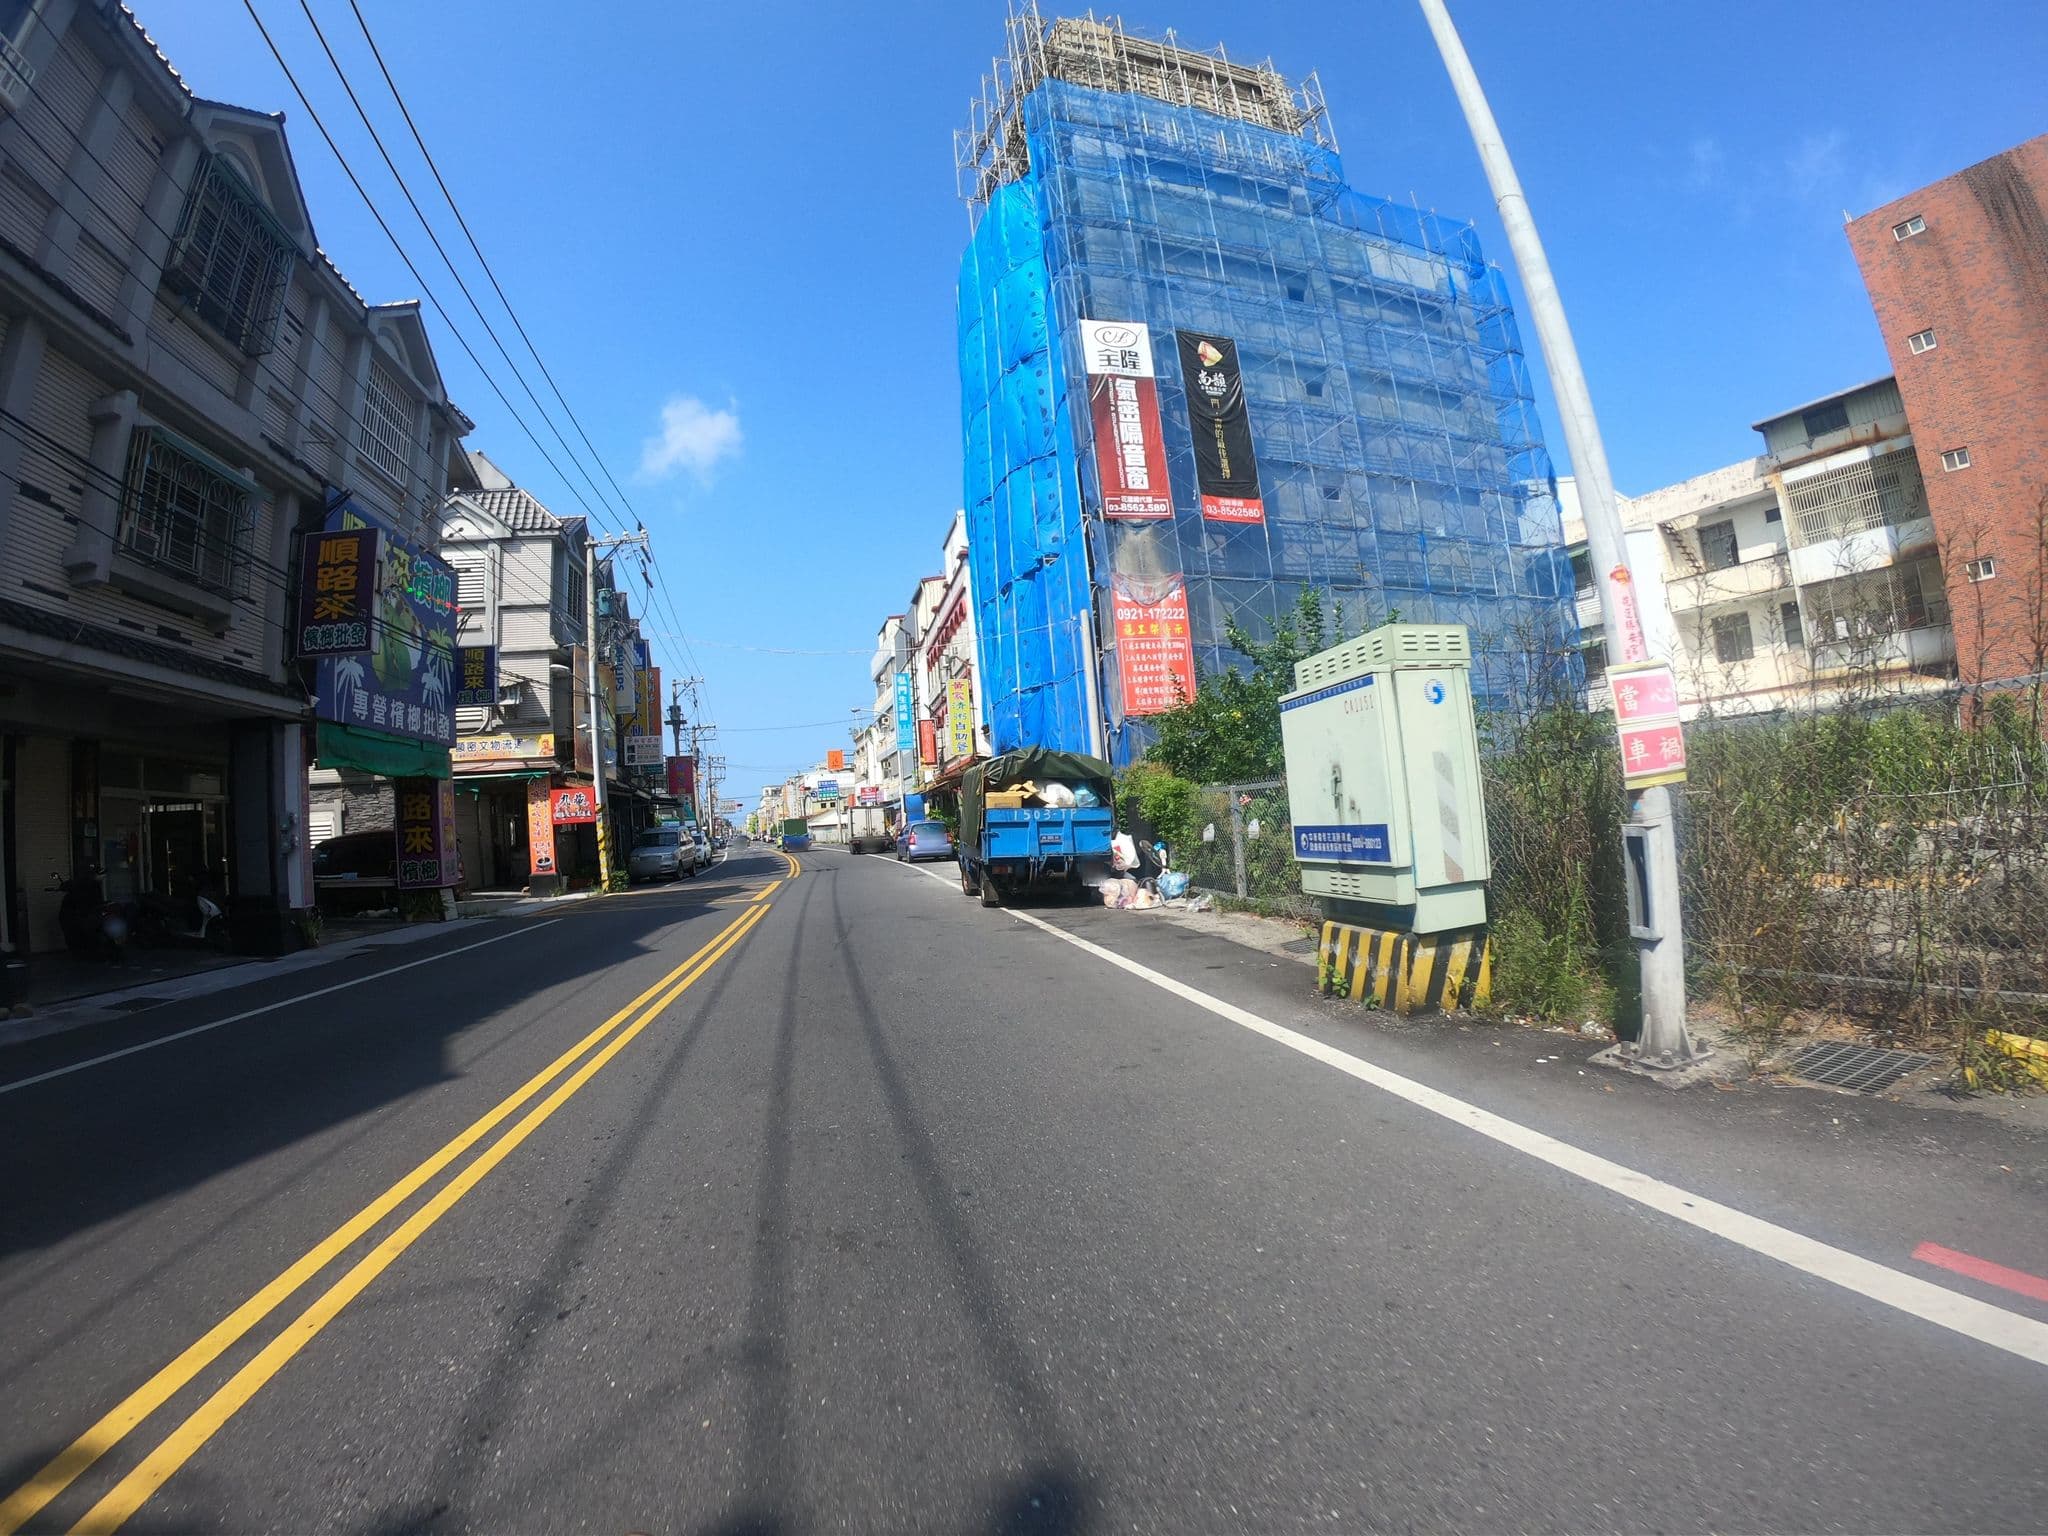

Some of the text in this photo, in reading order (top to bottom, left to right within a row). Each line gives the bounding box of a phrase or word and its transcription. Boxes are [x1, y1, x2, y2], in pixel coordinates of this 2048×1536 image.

[313, 538, 360, 620] 順路來
[303, 623, 367, 651] 檳榔批發
[464, 648, 485, 689] 順路來
[1617, 684, 1672, 711] 當心
[352, 688, 450, 740] 專營檳榔批發
[1627, 736, 1681, 766] 車禍
[1013, 809, 1077, 821] 1503-TP
